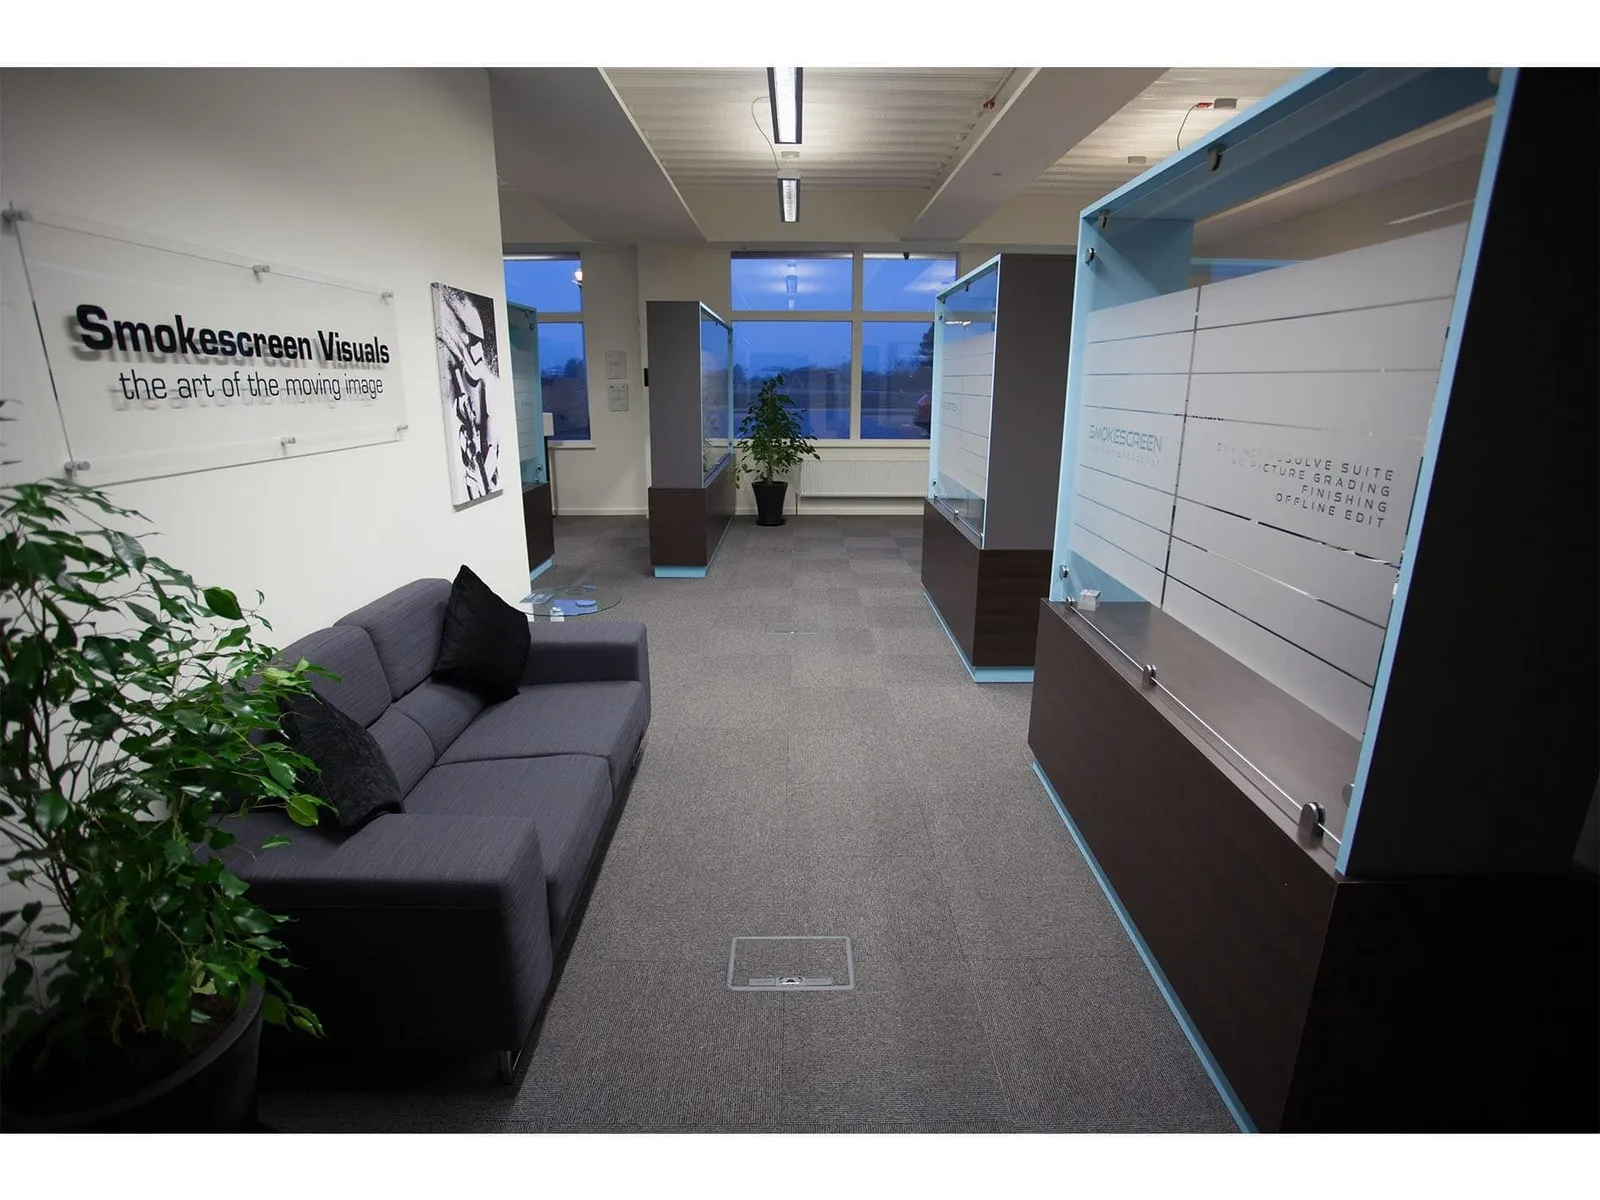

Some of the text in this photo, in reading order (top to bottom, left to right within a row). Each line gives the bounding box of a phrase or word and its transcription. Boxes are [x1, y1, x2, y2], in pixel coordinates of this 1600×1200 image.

[76, 304, 390, 364] Smokescreen Visuals
[119, 369, 384, 401] the art of the moving image
[1089, 424, 1163, 452] SMOKESCREEN
[1267, 450, 1332, 471] RSOLVE
[1341, 463, 1394, 481] SUITE
[1301, 485, 1387, 513] FINISHING
[1313, 473, 1390, 497] GRADING
[1275, 493, 1385, 528] OFFLINE EDIT
